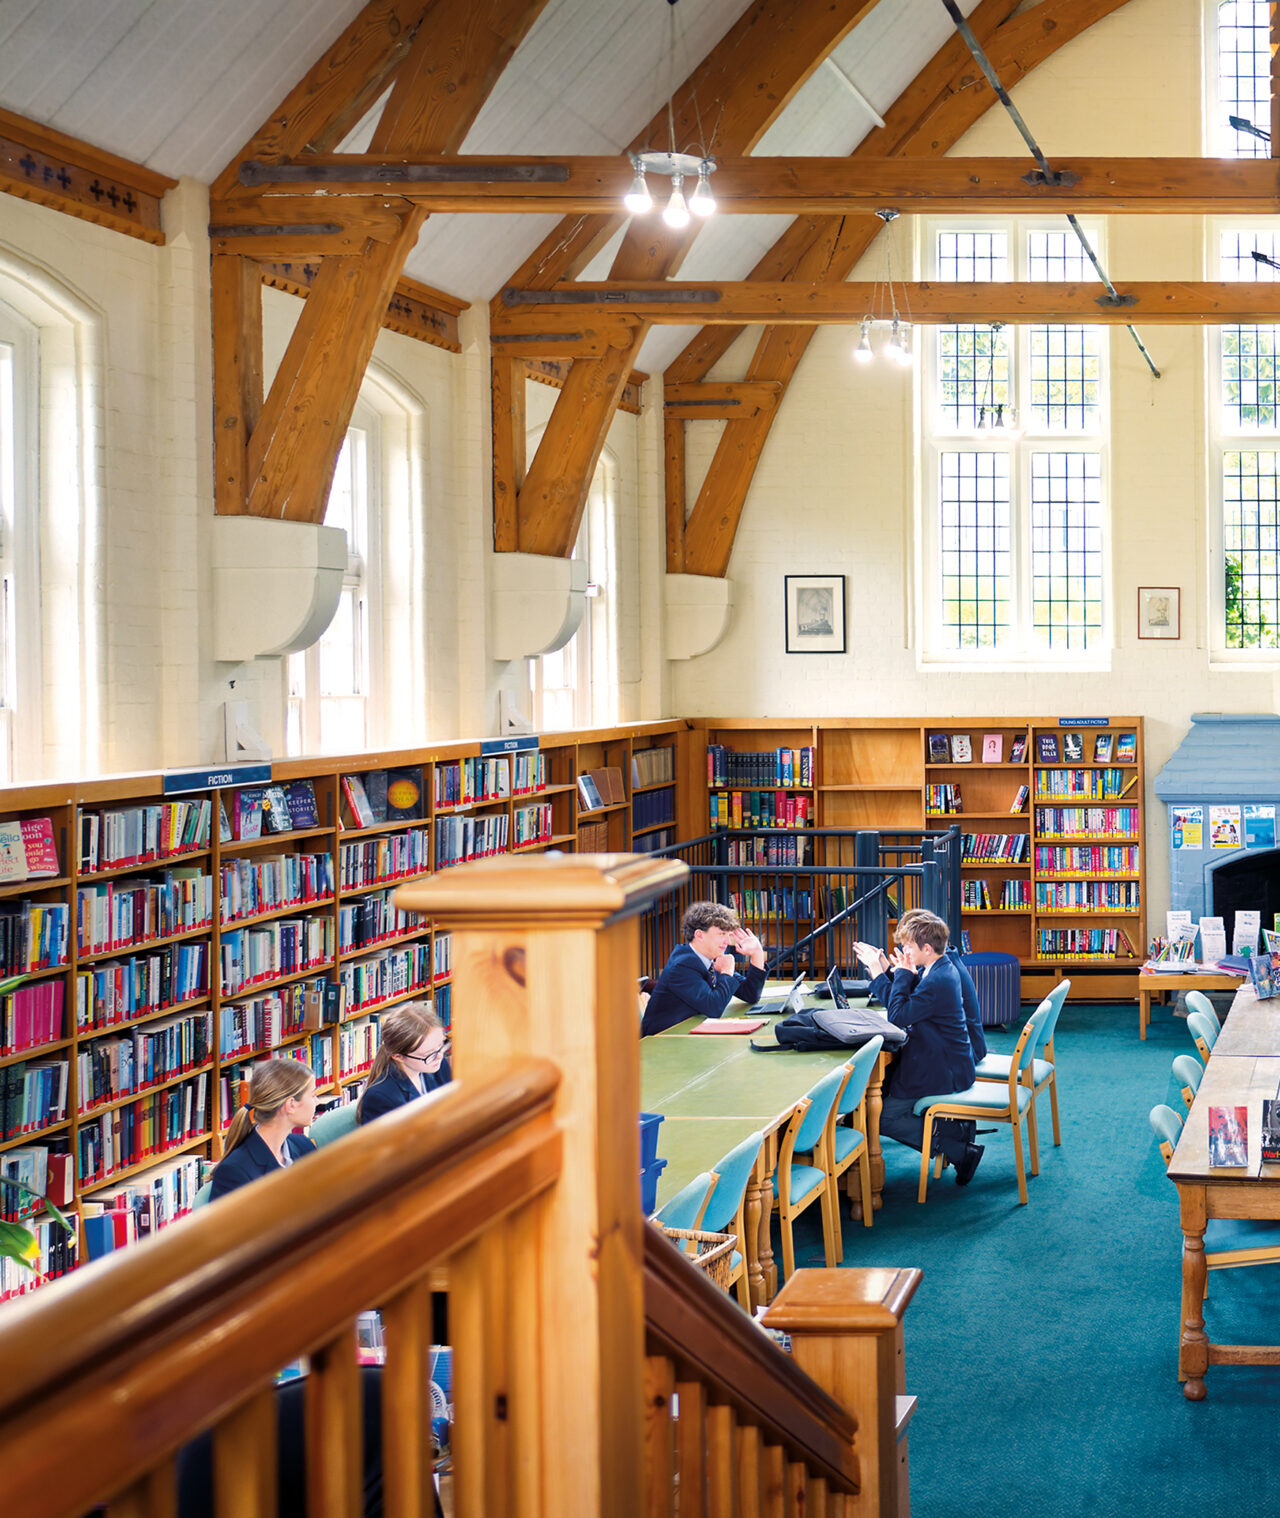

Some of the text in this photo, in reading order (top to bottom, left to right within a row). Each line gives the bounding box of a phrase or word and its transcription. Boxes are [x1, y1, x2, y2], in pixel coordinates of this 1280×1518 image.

[504, 742, 518, 750] FICTION
[208, 774, 233, 786] FICTION
[288, 798, 312, 806] KEEPER
[288, 805, 315, 814] STORIES
[21, 824, 44, 833] aige
[22, 832, 43, 840] oon
[263, 1007, 272, 1047] INSOMNIA
